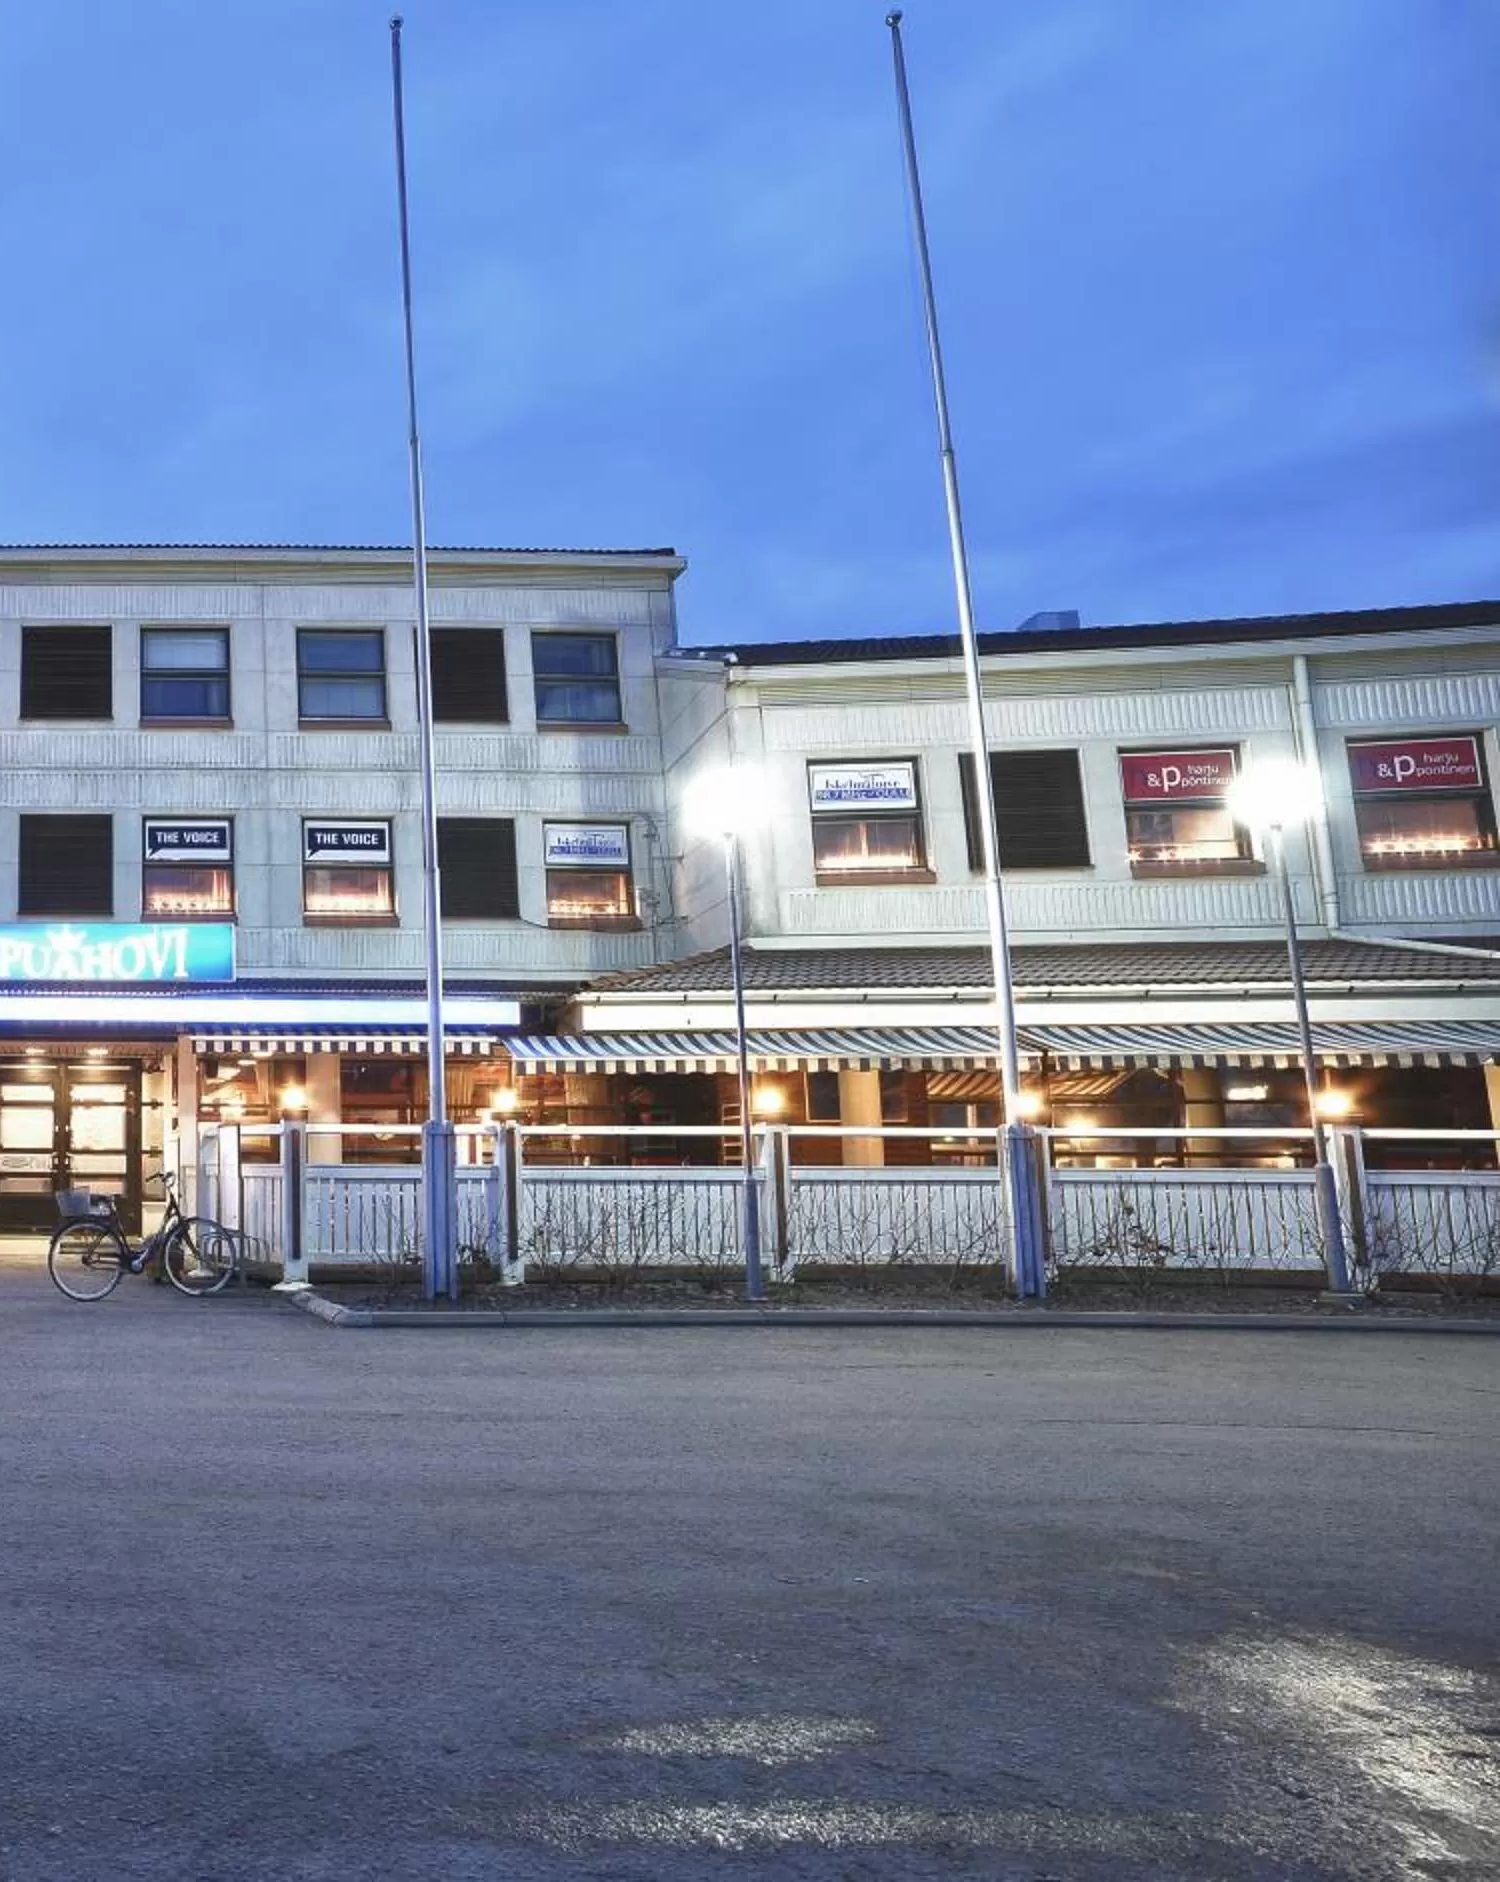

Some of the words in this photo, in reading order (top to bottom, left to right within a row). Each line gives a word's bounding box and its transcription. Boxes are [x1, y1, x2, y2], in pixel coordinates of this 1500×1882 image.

[156, 831, 180, 844] THE
[183, 831, 219, 844] VOICE
[315, 832, 340, 845] THE
[342, 833, 379, 846] VOICE
